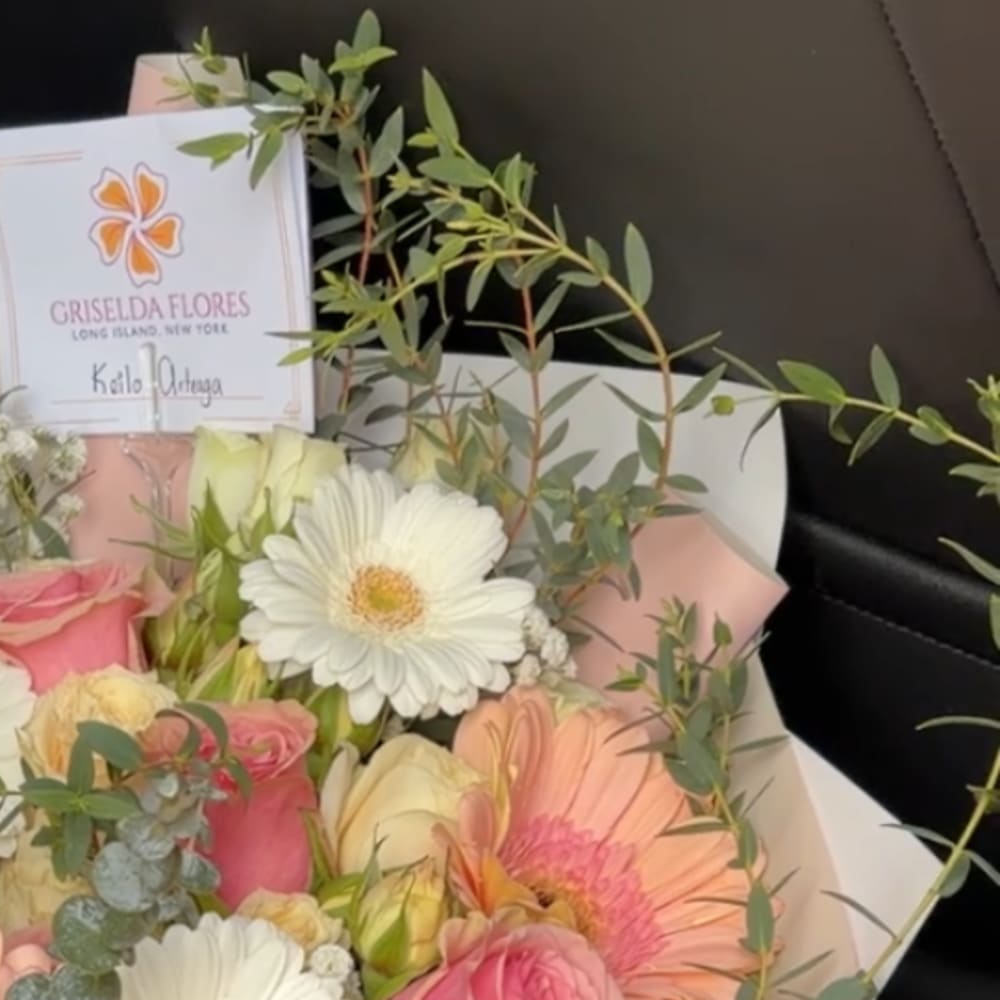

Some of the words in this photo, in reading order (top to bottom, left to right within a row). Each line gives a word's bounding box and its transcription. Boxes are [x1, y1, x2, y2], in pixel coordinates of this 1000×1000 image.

[50, 296, 164, 325] GRISELDA
[168, 291, 250, 319] FLORES
[72, 328, 108, 341] LONG
[165, 324, 191, 336] NEW
[196, 323, 229, 335] YORK
